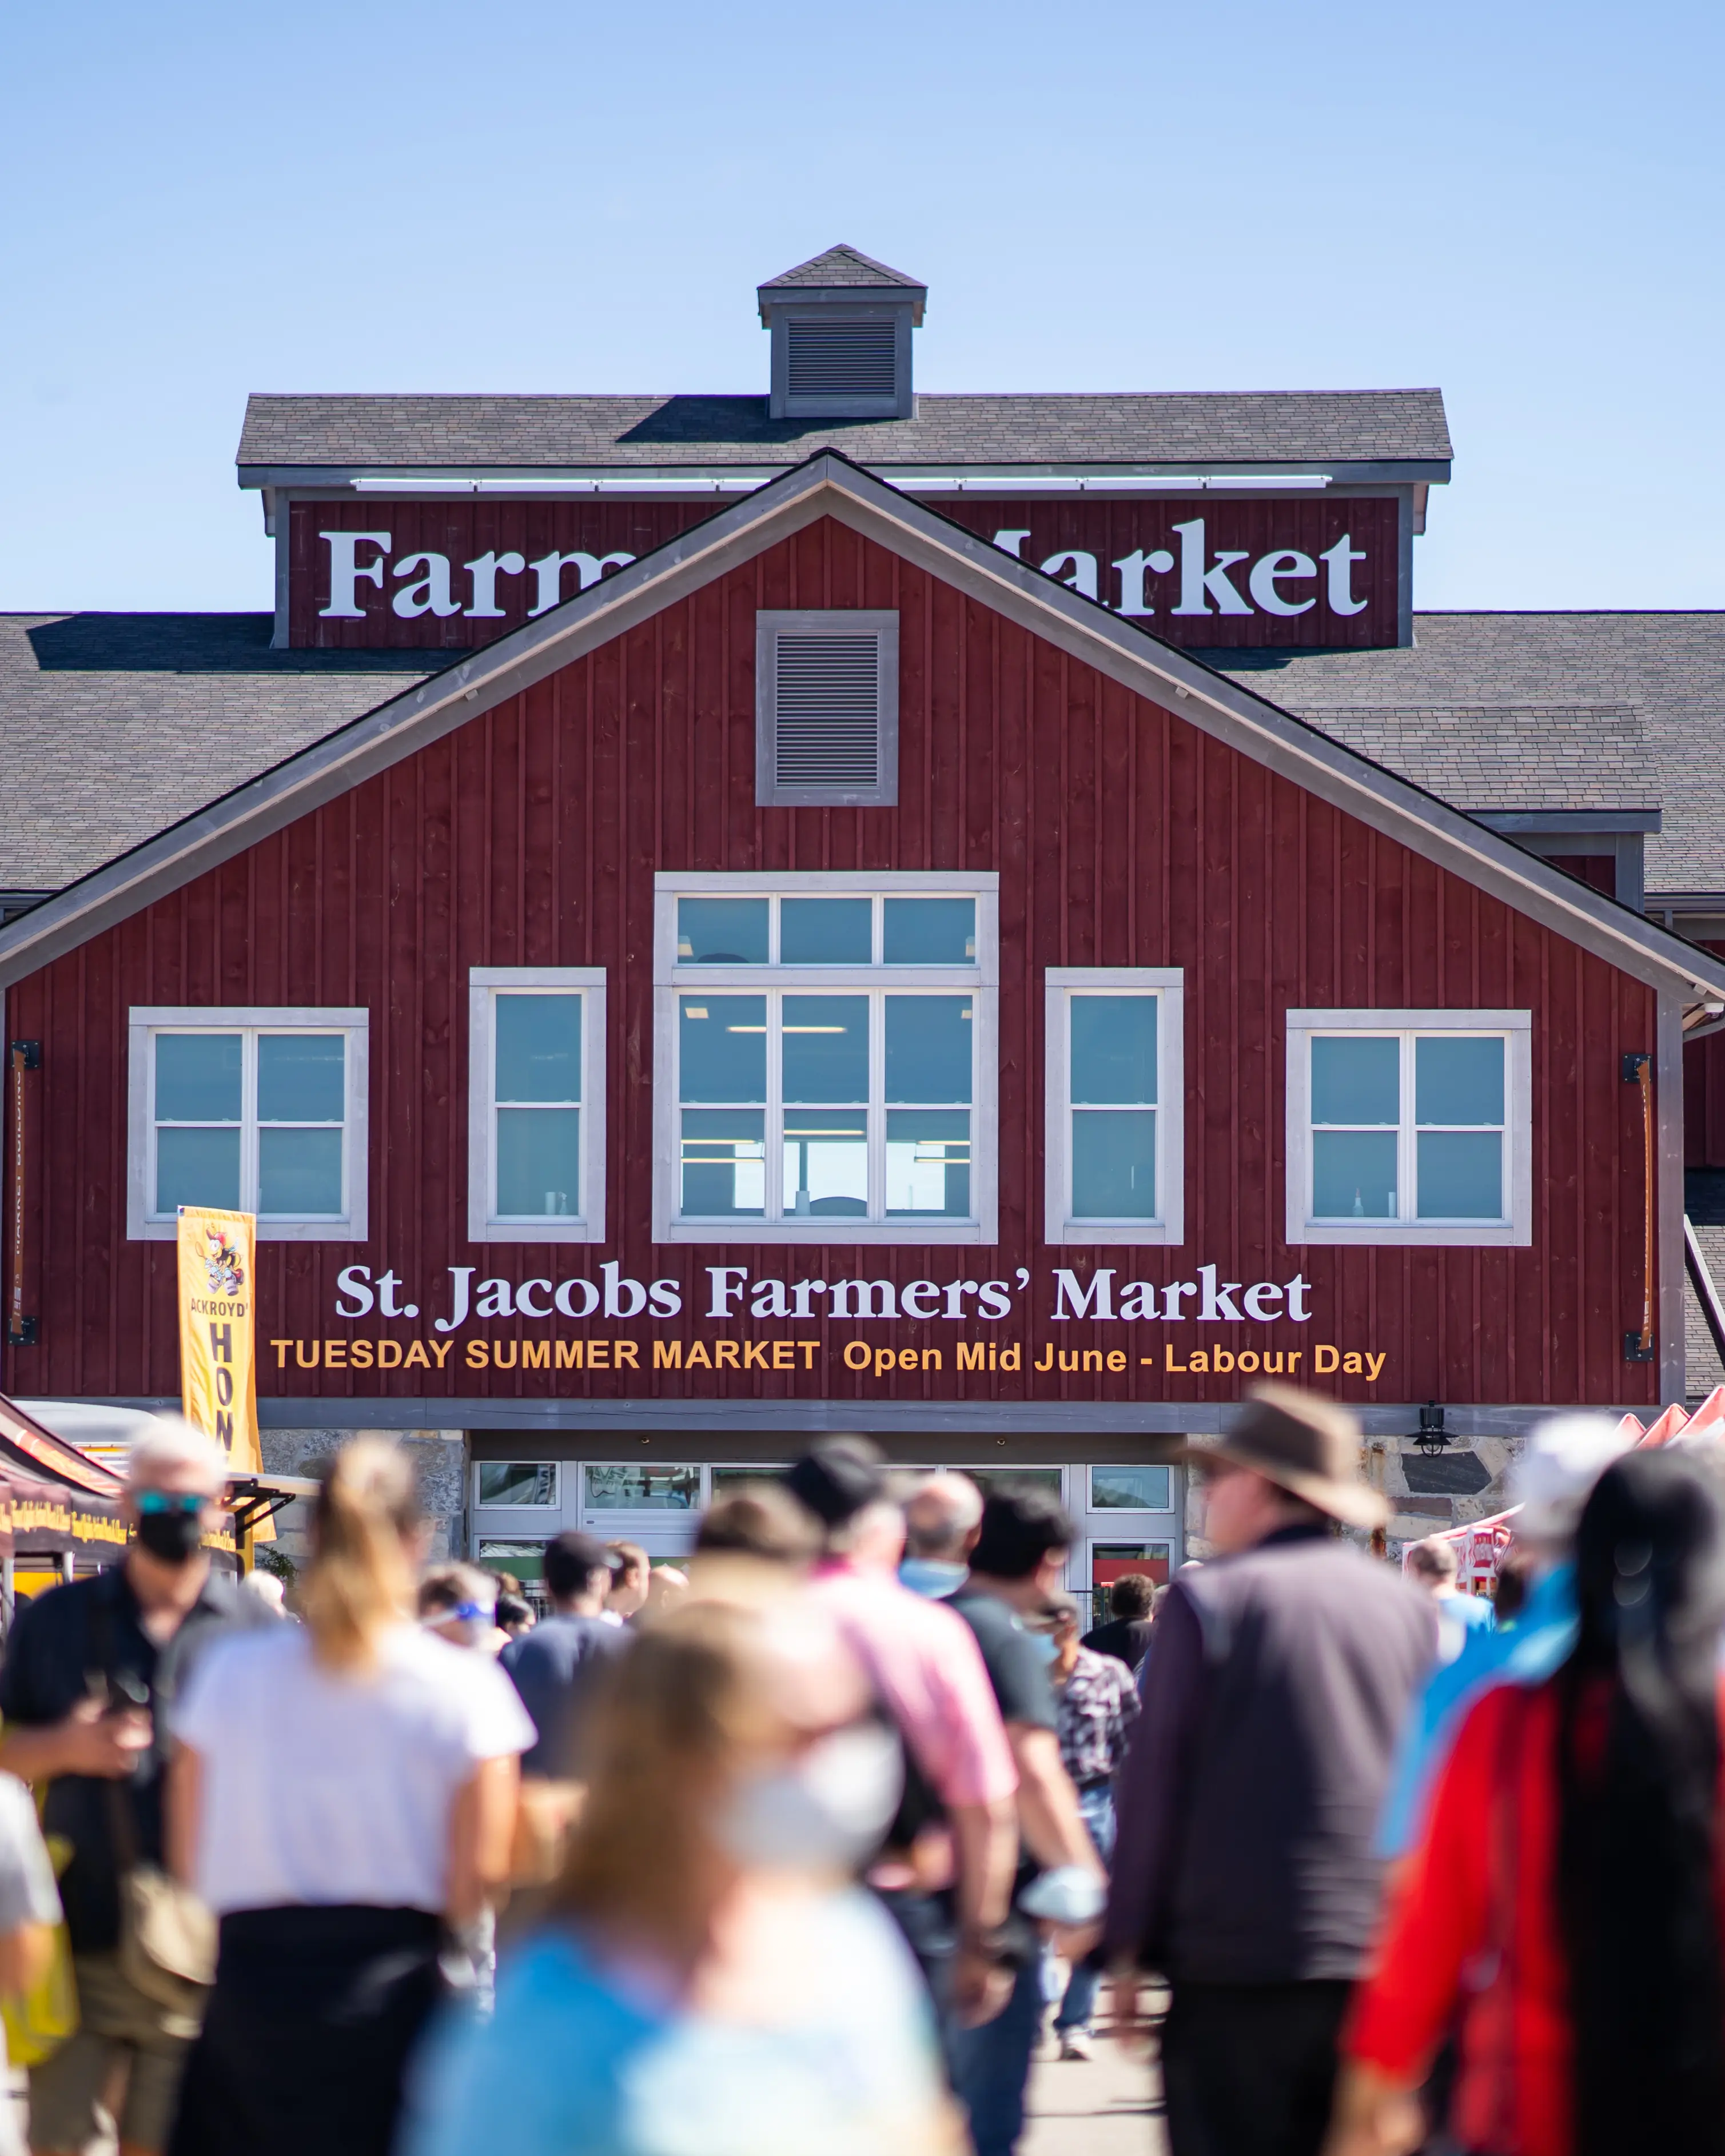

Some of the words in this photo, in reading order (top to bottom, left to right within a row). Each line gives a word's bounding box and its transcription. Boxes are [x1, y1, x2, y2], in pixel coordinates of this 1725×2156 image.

[993, 518, 1368, 616] arket
[336, 1265, 419, 1318] St.
[435, 1260, 682, 1332] Jacobs
[705, 1266, 1030, 1320] Farmers’
[1050, 1263, 1313, 1322] Market
[209, 1322, 234, 1465] HON
[270, 1339, 453, 1369] TUESDAY
[465, 1339, 640, 1369] SUMMER
[653, 1340, 821, 1369] MARKET
[843, 1340, 942, 1377] Open
[957, 1341, 1021, 1372] Mid
[1034, 1342, 1127, 1372] June
[1165, 1344, 1302, 1373] Labour
[1314, 1344, 1387, 1382] Day
